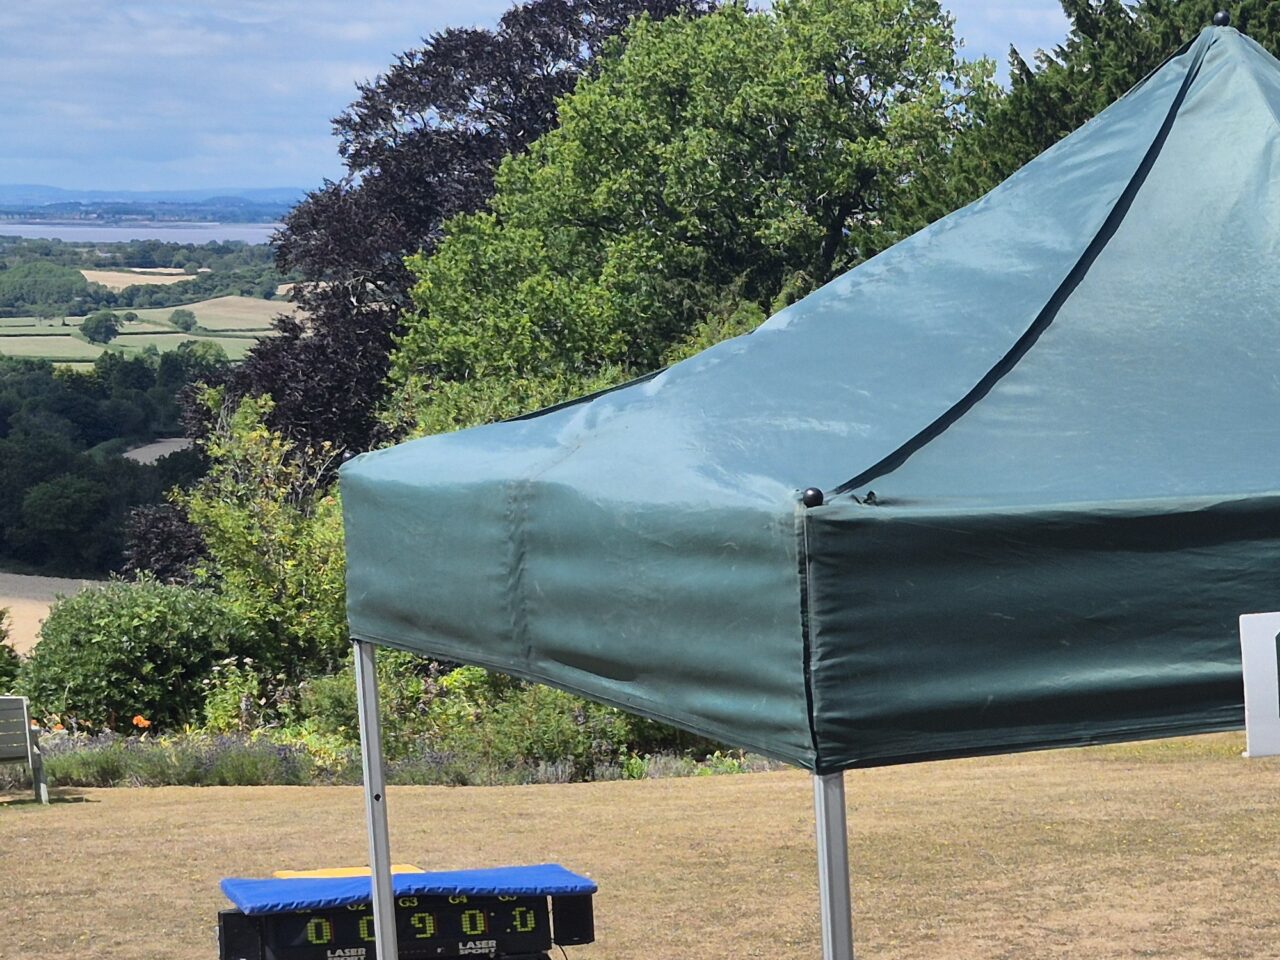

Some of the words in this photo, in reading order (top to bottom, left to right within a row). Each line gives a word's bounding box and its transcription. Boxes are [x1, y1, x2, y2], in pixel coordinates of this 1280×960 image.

[307, 918, 331, 944] 0
[411, 912, 434, 938] 9
[461, 909, 484, 935] 0
[459, 940, 497, 949] LASER
[327, 947, 366, 957] LASER
